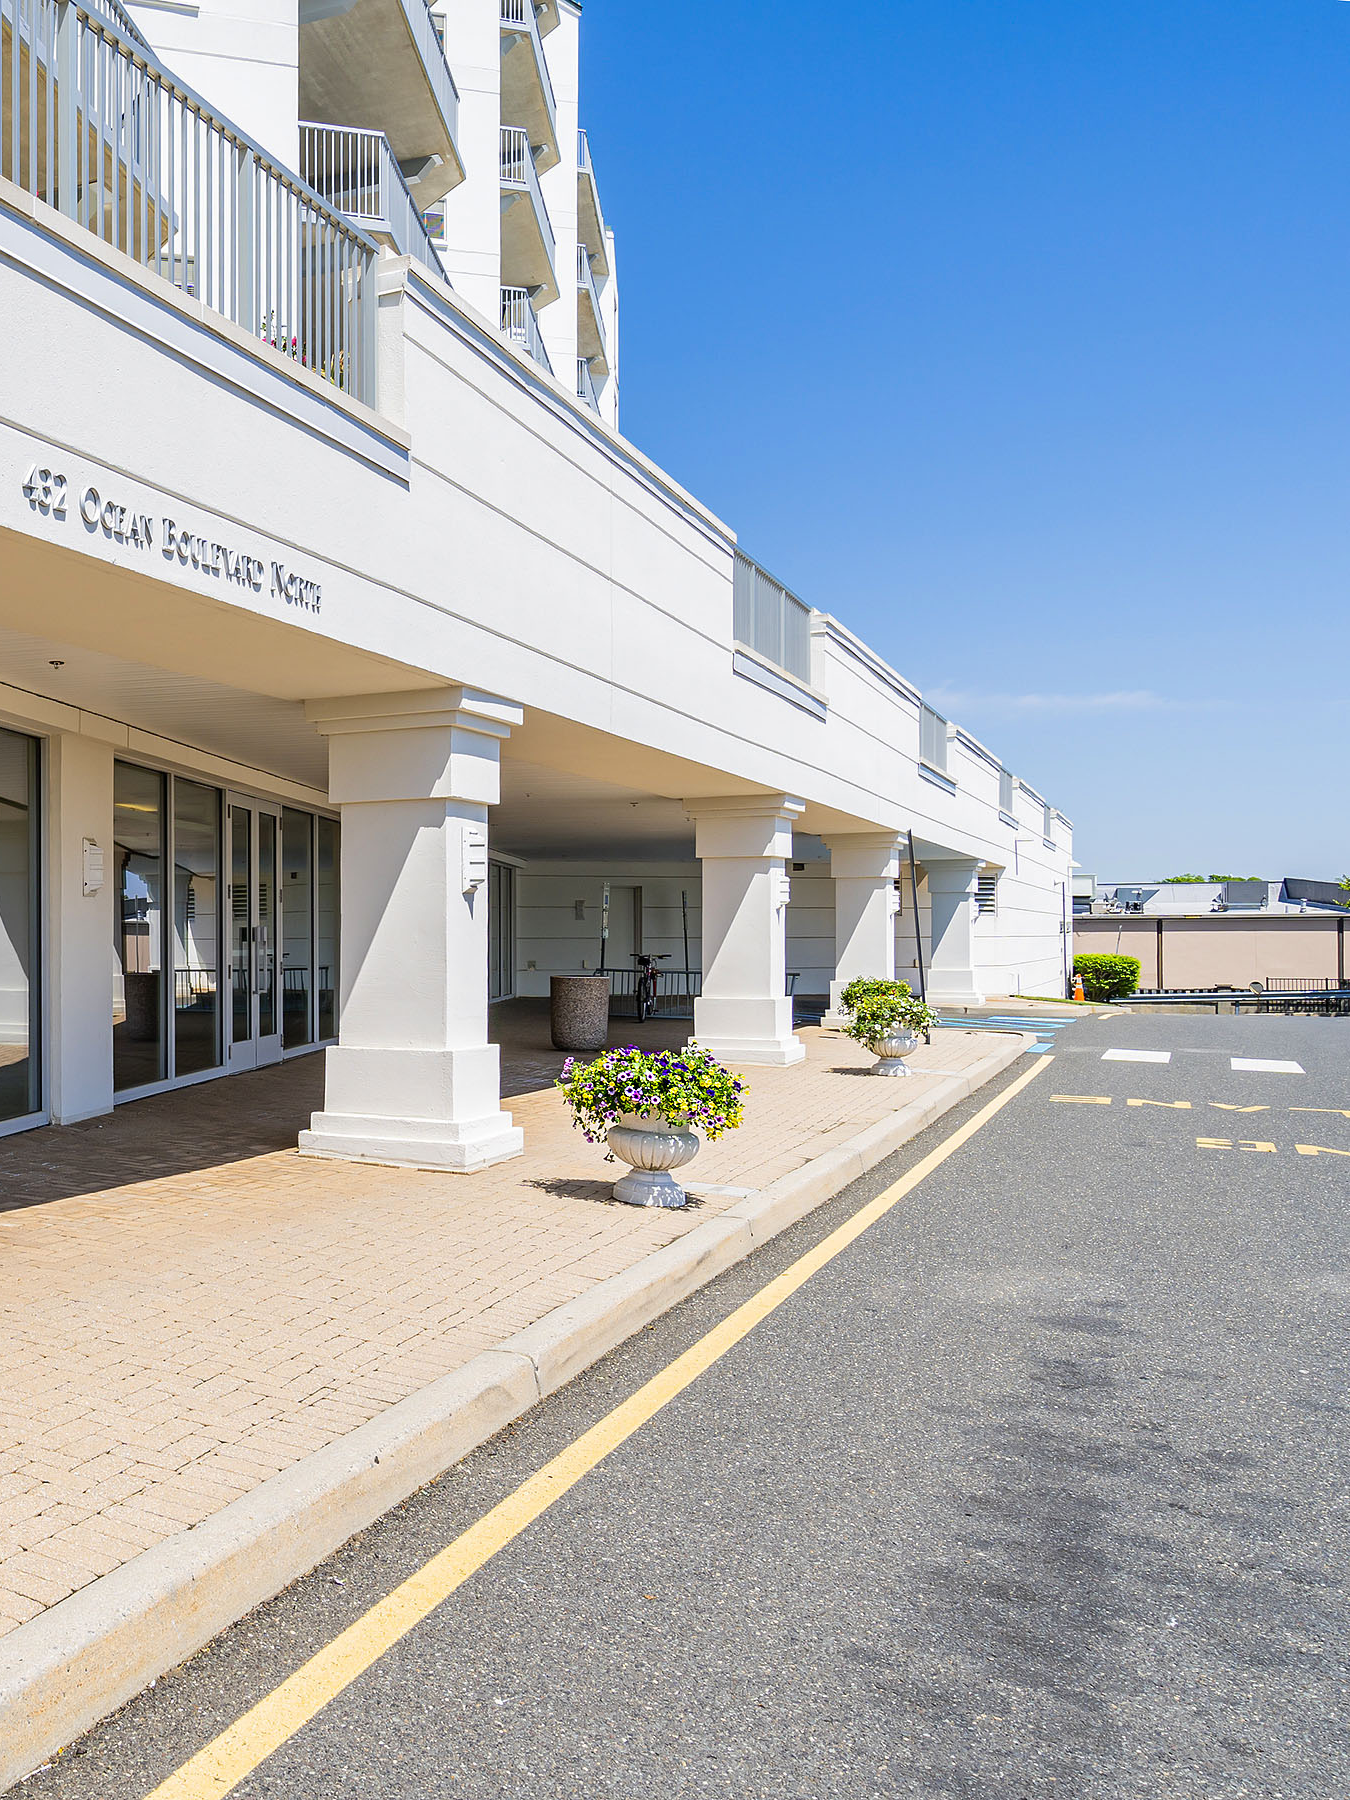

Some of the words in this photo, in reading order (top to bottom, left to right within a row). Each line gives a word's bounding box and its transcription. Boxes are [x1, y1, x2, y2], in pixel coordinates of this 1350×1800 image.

[21, 463, 68, 518] 432
[79, 486, 154, 548] OCEAN
[161, 517, 265, 592] BOULEVARD
[270, 561, 323, 612] NORTH
